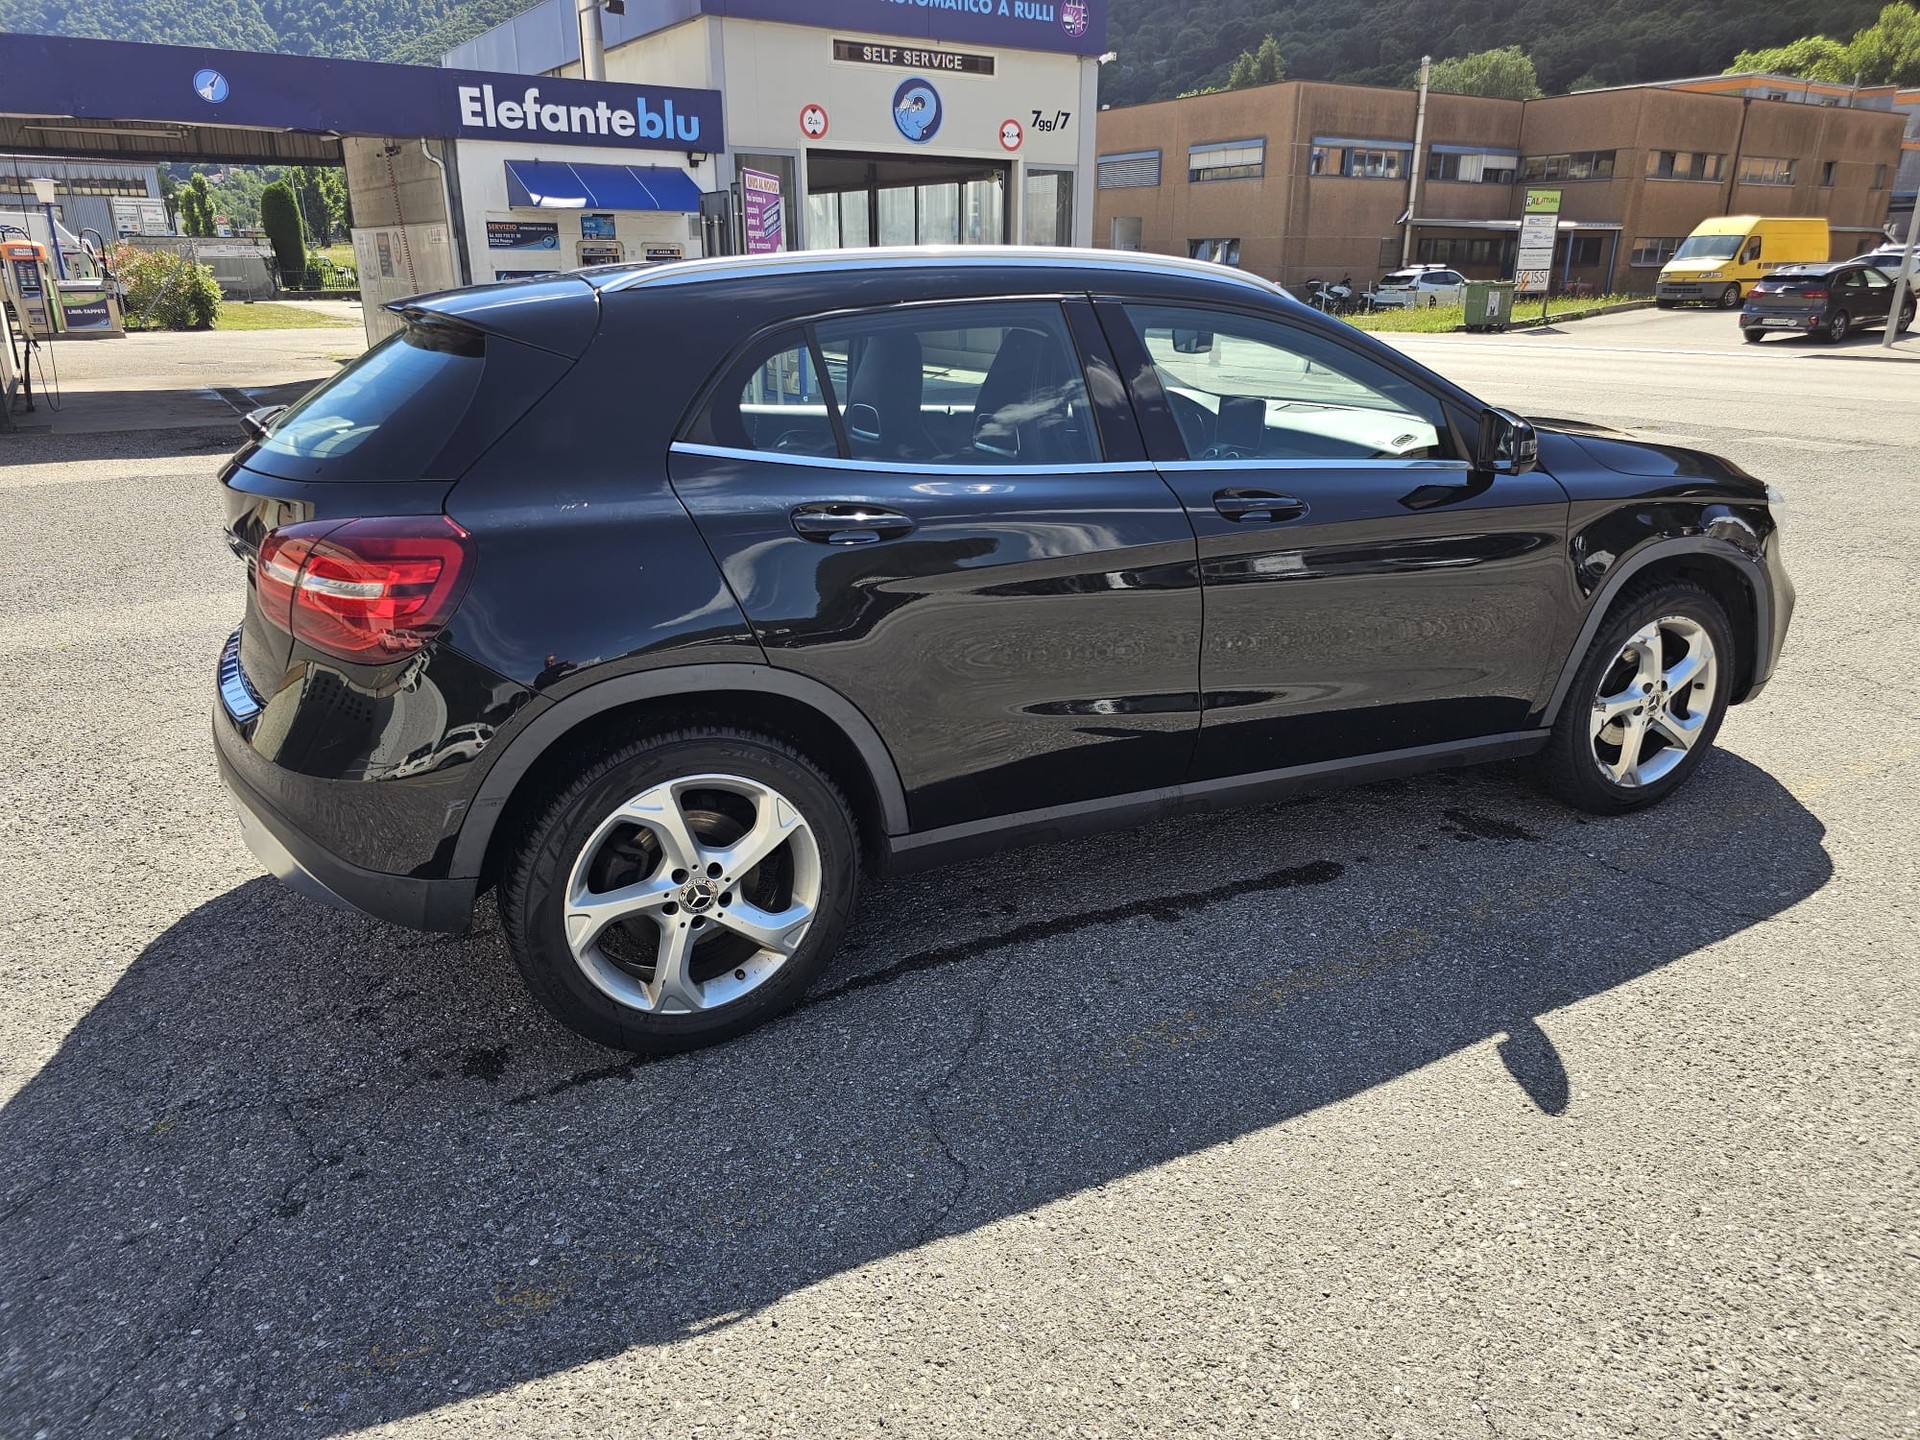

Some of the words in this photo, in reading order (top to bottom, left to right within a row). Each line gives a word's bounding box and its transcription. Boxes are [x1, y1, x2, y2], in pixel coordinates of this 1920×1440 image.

[998, 1, 1009, 16] A
[1014, 3, 1054, 22] RULLI
[863, 46, 897, 63] SELF
[903, 50, 963, 70] SERVICE
[1031, 110, 1071, 132] 7gg/7
[488, 223, 517, 231] SERVIZIO
